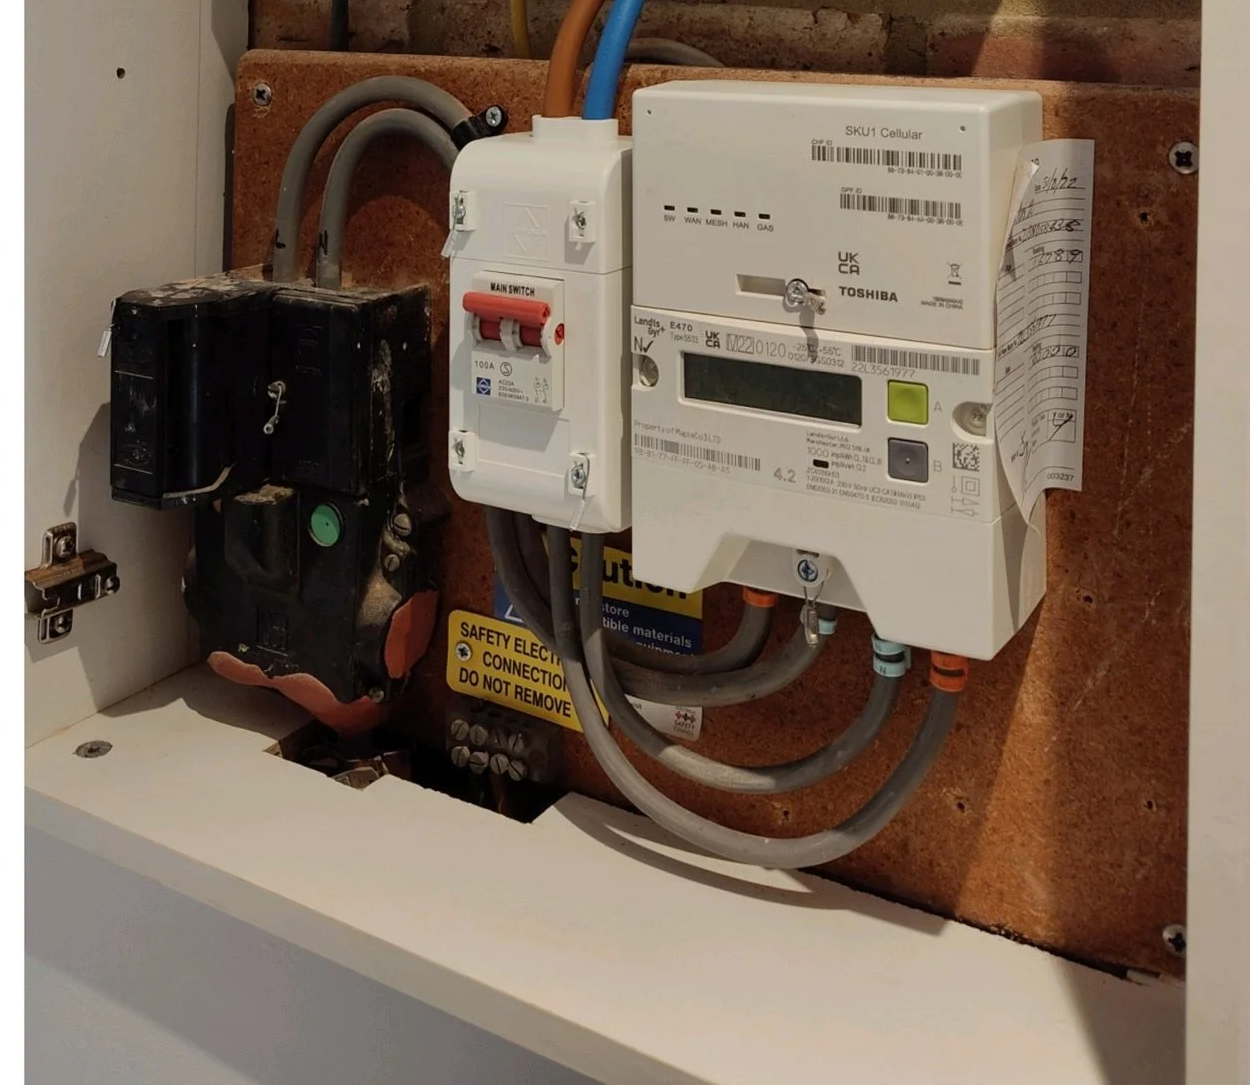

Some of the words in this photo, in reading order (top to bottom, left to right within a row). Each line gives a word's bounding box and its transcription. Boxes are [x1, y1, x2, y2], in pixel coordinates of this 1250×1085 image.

[845, 125, 876, 137] SKU1
[880, 127, 923, 140] Cellular
[490, 282, 507, 293] MAIN
[508, 284, 535, 296] SWITCH
[838, 285, 898, 302] TOSHIBA
[474, 360, 495, 370] 100A
[460, 621, 511, 649] SAFETY
[633, 624, 693, 649] materials
[458, 666, 479, 687] DO
[482, 674, 511, 696] NOT
[514, 684, 571, 718] REMOVE
